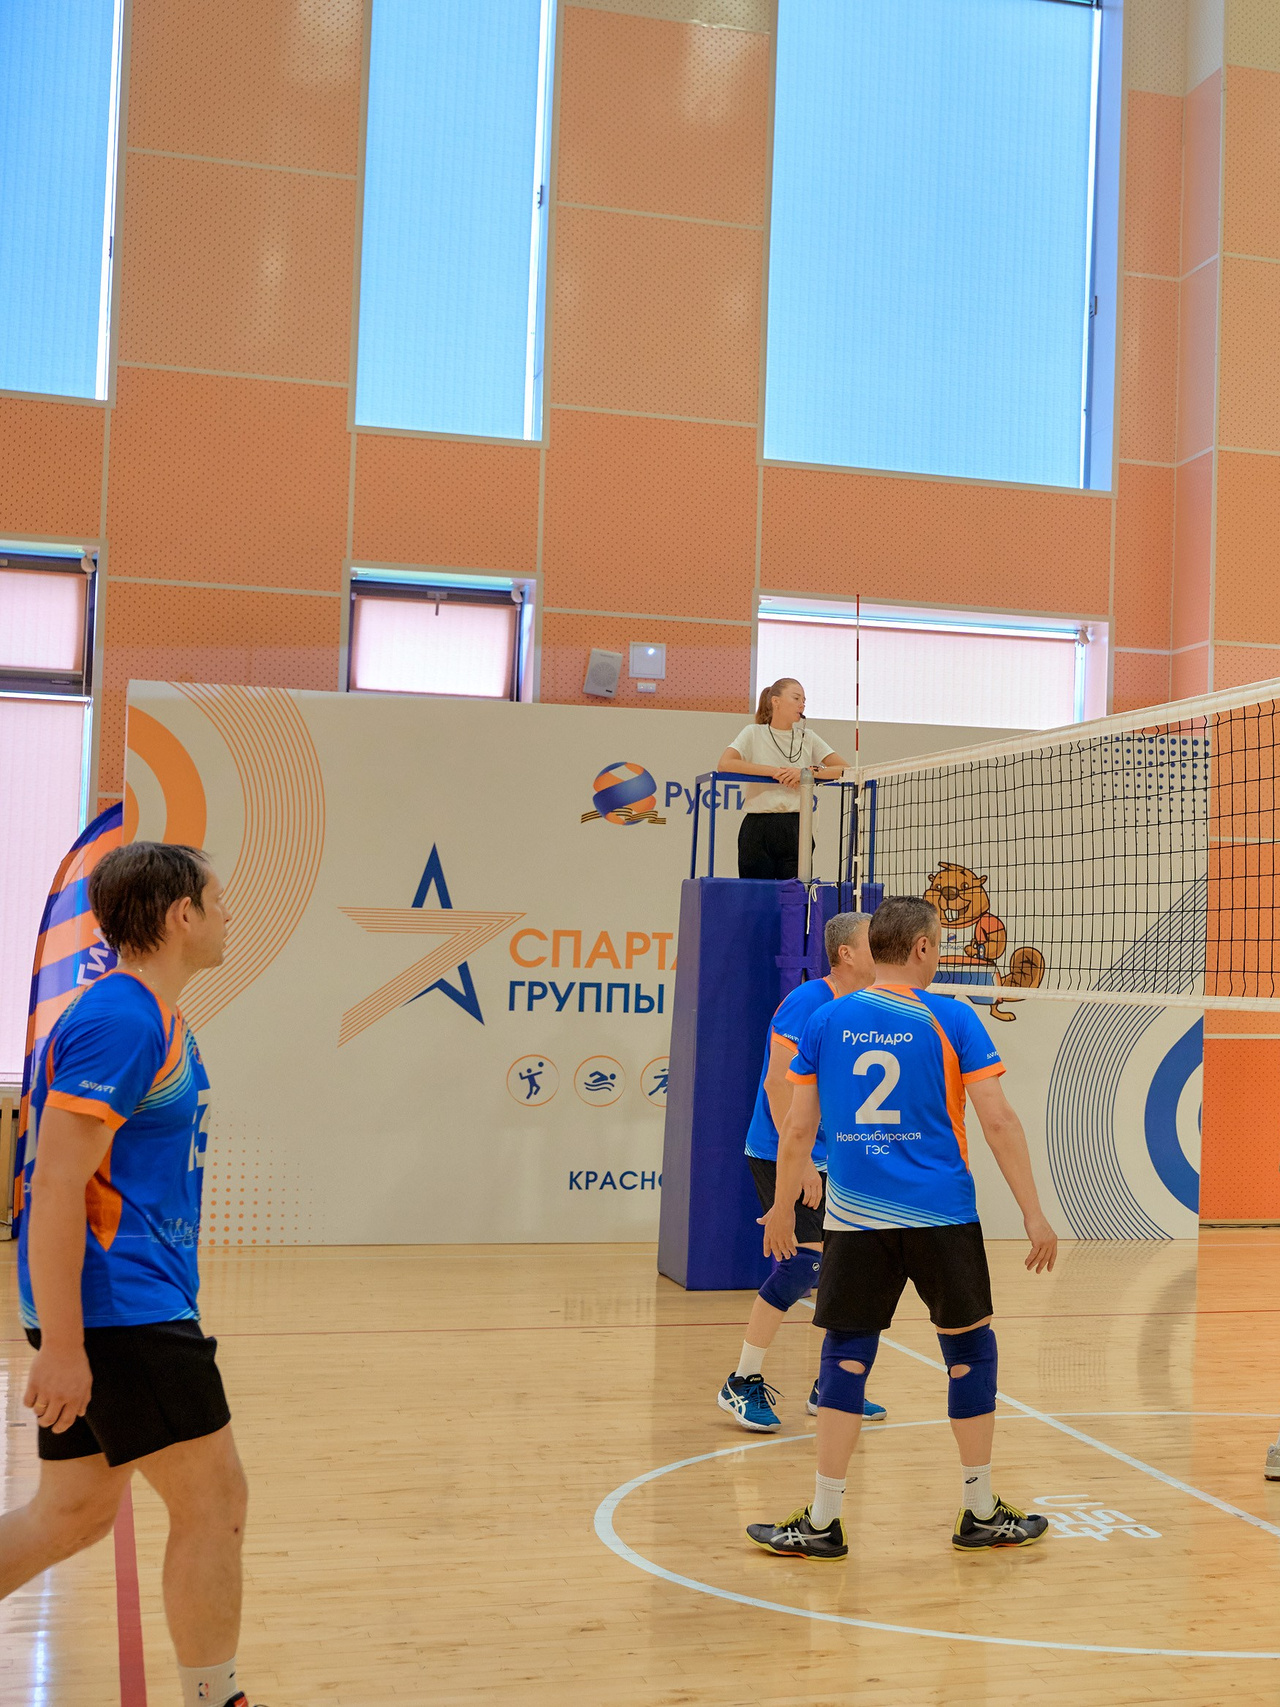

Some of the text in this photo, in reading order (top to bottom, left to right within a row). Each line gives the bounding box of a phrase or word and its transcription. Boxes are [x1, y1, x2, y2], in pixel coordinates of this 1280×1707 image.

[509, 928, 678, 970] СПАРТ
[508, 980, 665, 1014] ГРУППЫ
[842, 1029, 913, 1045] РусГидро
[852, 1049, 901, 1125] 2
[836, 1130, 921, 1144] Новосибирская
[865, 1145, 890, 1155] ГЭС
[569, 1170, 662, 1191] КРАСН
